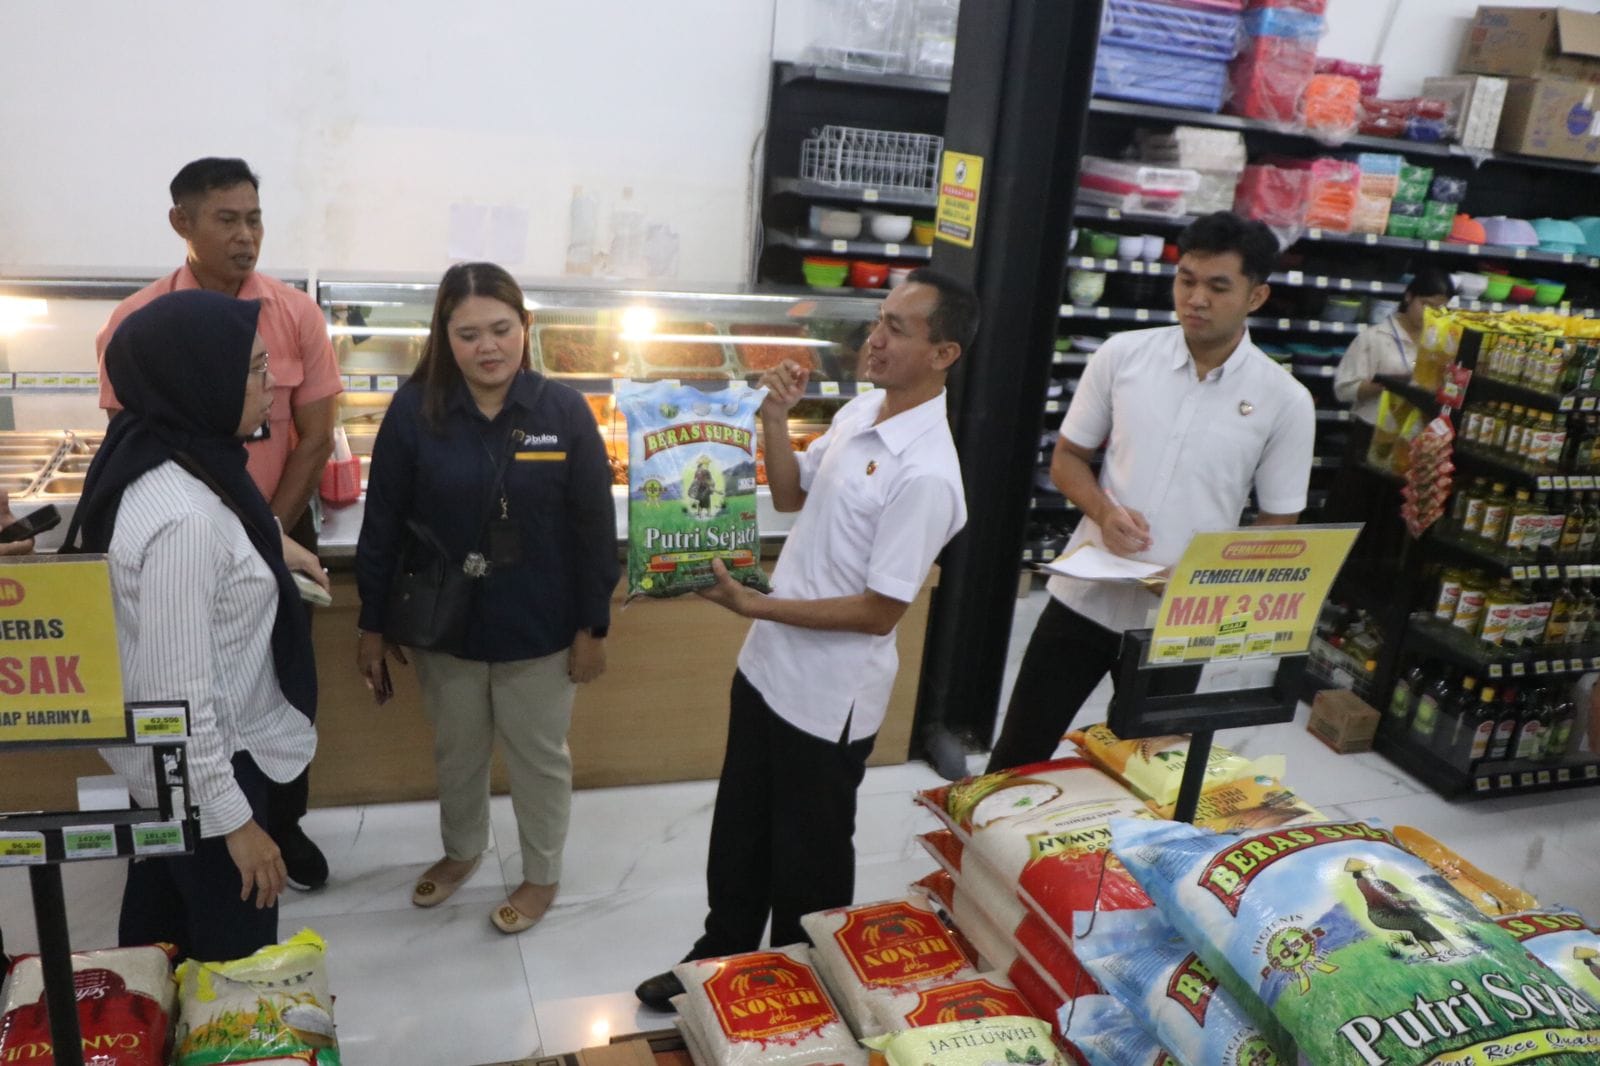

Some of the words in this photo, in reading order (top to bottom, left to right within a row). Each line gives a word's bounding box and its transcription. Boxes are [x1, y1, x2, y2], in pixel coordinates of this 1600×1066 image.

[531, 433, 558, 445] bulog
[646, 424, 700, 451] BERAS
[646, 526, 700, 549] Putri
[706, 523, 756, 551] Sejati
[1189, 568, 1264, 585] PEMBELIAN
[1266, 567, 1310, 583] BERAS
[1165, 595, 1230, 627] MAX
[1231, 594, 1252, 616] 3
[1254, 592, 1306, 622] SAK
[0, 618, 64, 641] ERAS
[1187, 635, 1216, 649] LANGG
[0, 655, 86, 696] SAK
[27, 709, 92, 726] HARINYA
[1038, 828, 1113, 852] KAWAN
[1208, 830, 1316, 896] BERAS
[863, 937, 949, 968] RENON
[730, 989, 819, 1019] RENON
[1337, 979, 1496, 1066] Putri
[1481, 971, 1600, 1031] Seja
[928, 1026, 1037, 1055] JATILUWIH
[1482, 1039, 1537, 1062] Rice
